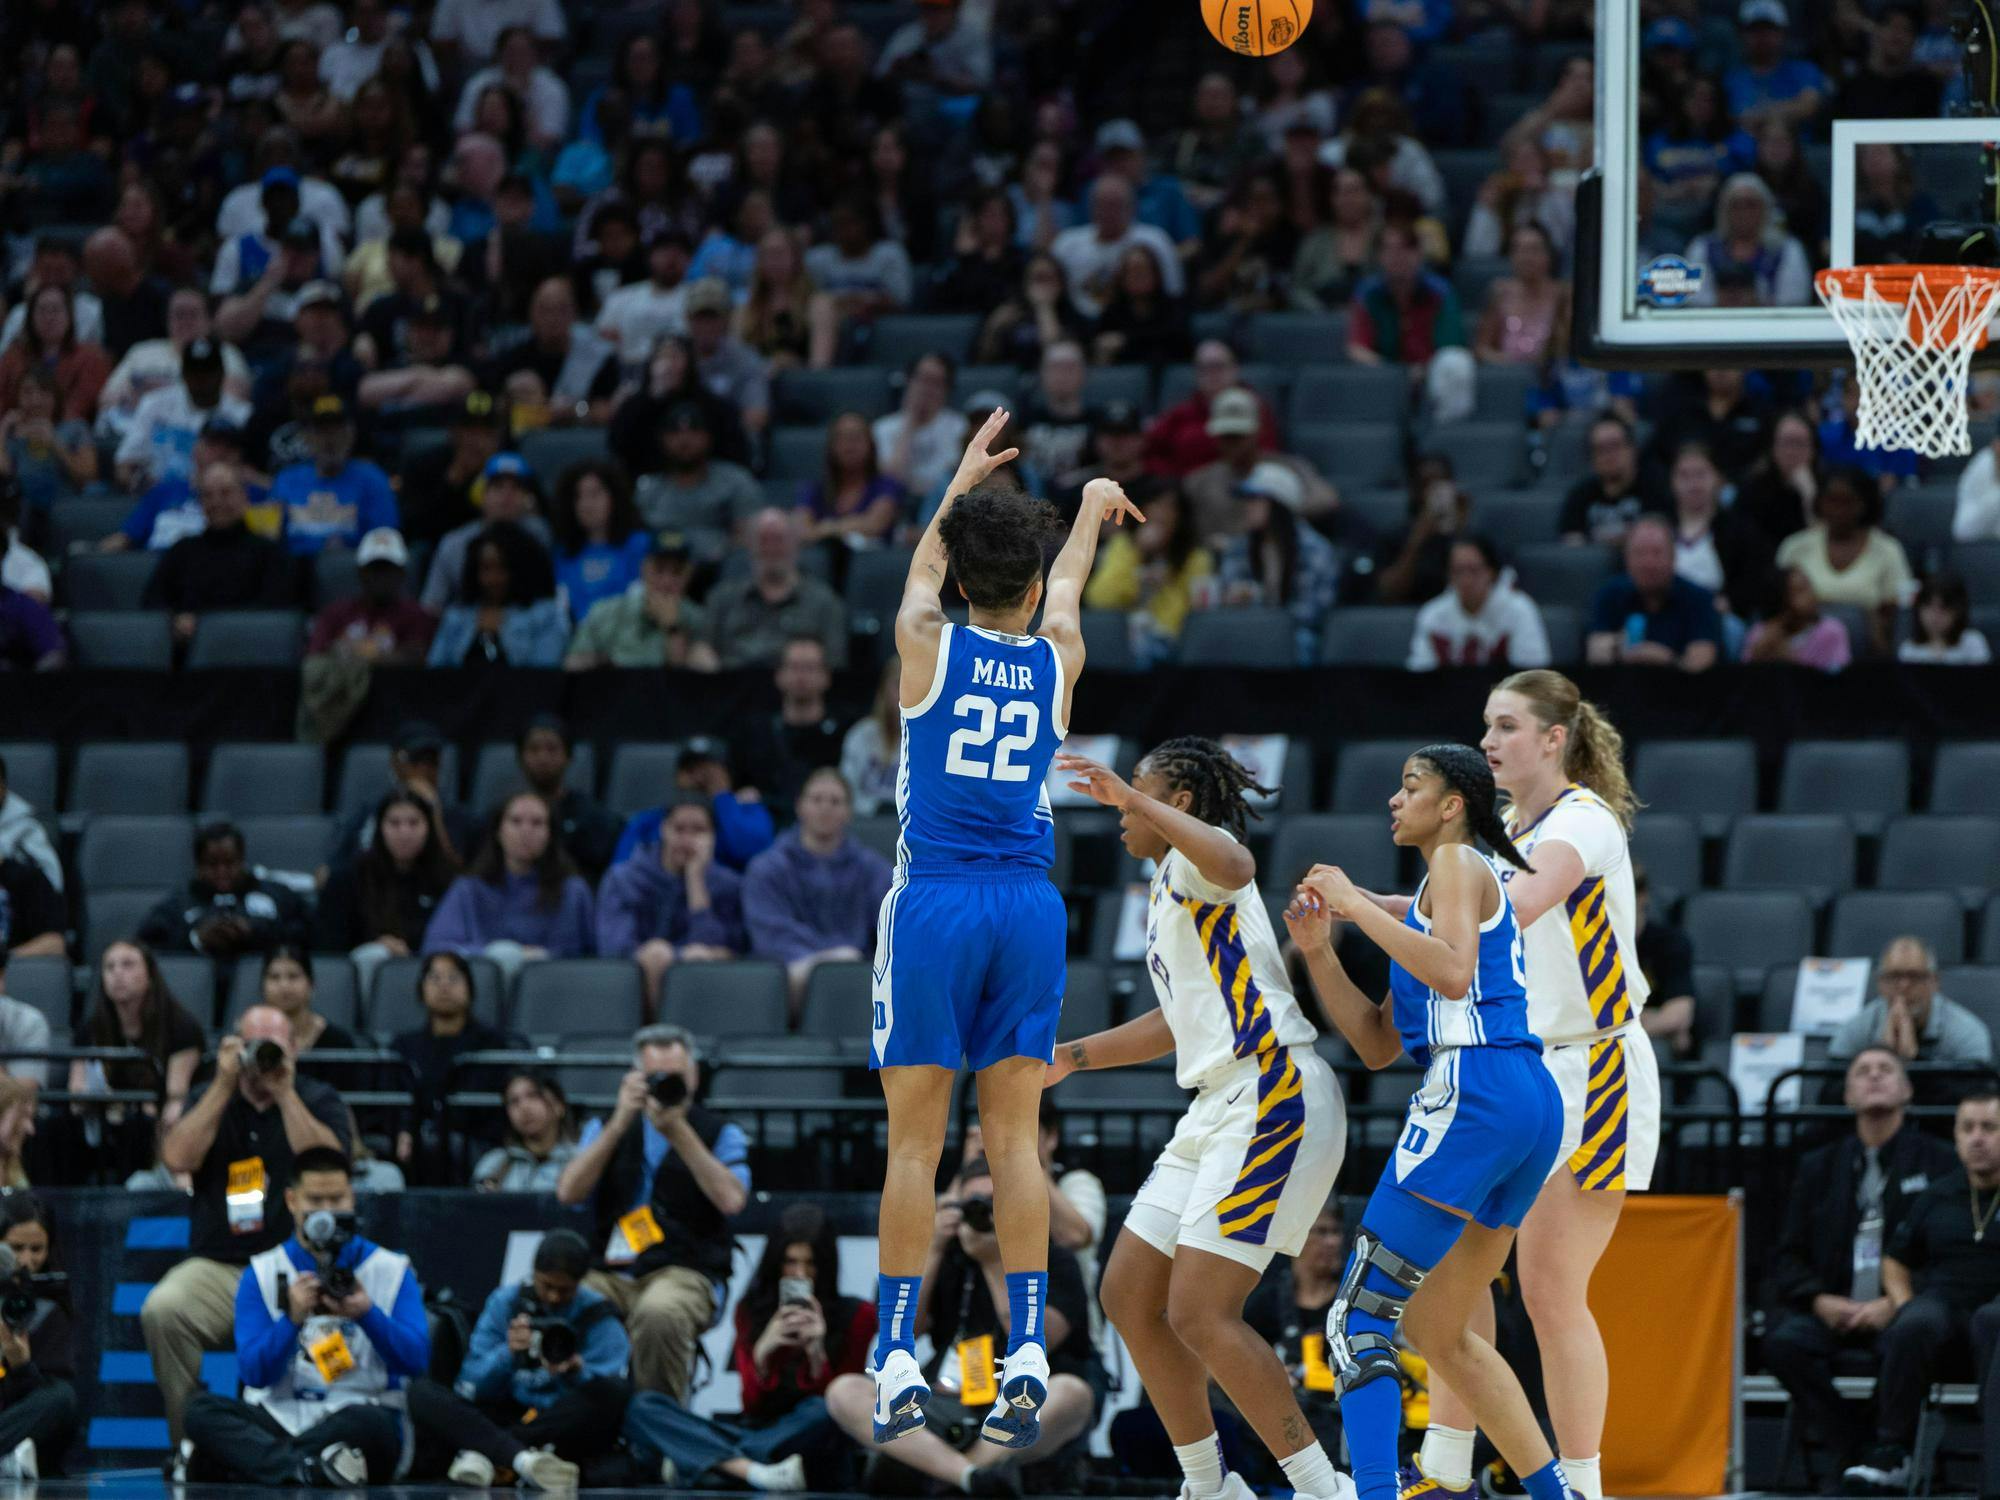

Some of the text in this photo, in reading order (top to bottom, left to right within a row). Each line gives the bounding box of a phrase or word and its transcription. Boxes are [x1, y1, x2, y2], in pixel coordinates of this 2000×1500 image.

[972, 657, 1034, 690] MAIR
[945, 694, 1040, 782] 22
[874, 1000, 887, 1030] D
[1401, 1122, 1429, 1155] D
